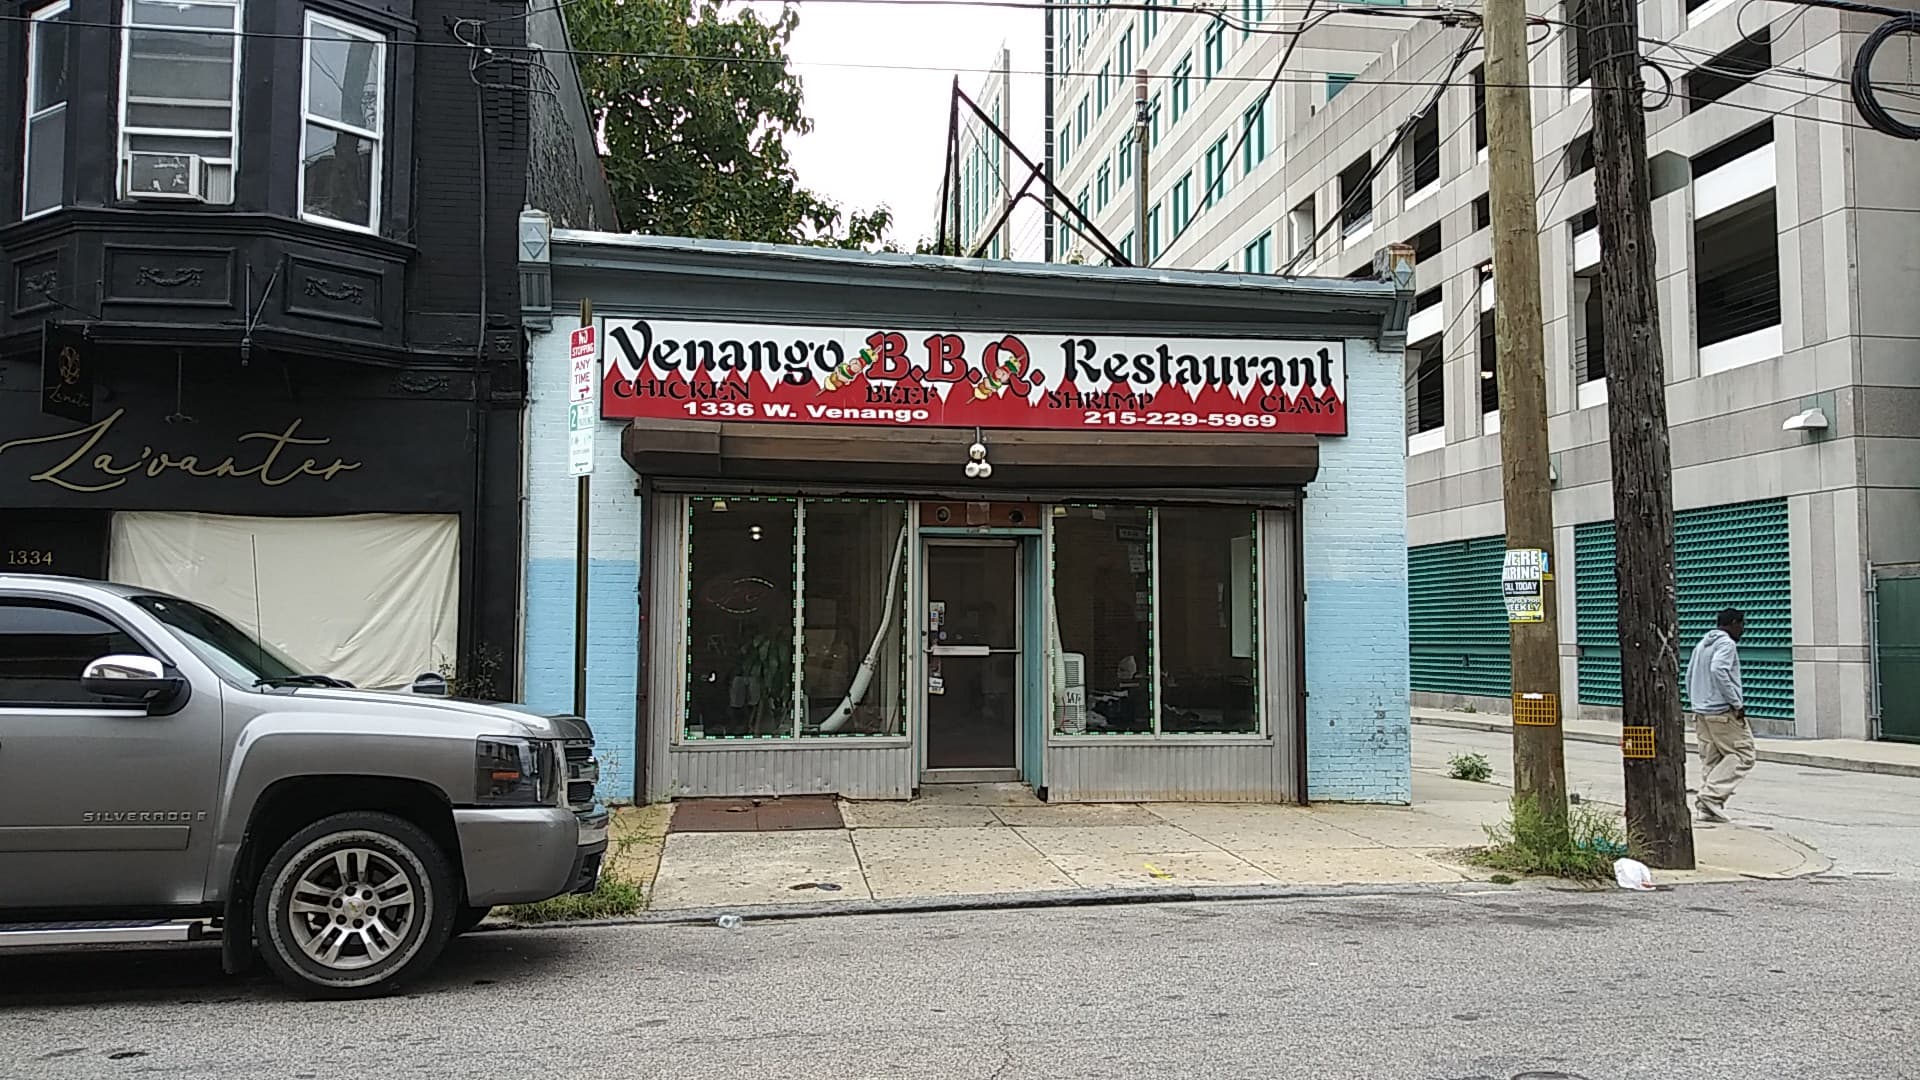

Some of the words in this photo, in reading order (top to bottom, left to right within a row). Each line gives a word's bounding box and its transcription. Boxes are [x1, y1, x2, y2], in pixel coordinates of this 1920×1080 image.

[579, 329, 588, 344] NO
[575, 358, 590, 371] ANY
[609, 320, 844, 385] Venango
[866, 331, 1045, 397] B.B.Q.
[1060, 338, 1334, 387] Restaurant
[574, 371, 591, 385] TIME
[613, 378, 749, 400] CHICKEN
[866, 385, 938, 405] BEEF
[1048, 390, 1154, 410] SHRIMP
[1260, 395, 1335, 414] CLAM
[571, 408, 577, 428] 2
[683, 401, 754, 417] 1336
[763, 403, 798, 418] W.
[806, 404, 929, 423] Venango
[1083, 411, 1277, 427] 215-229-5969
[8, 550, 53, 566] 1334
[1515, 582, 1537, 590] TODAY
